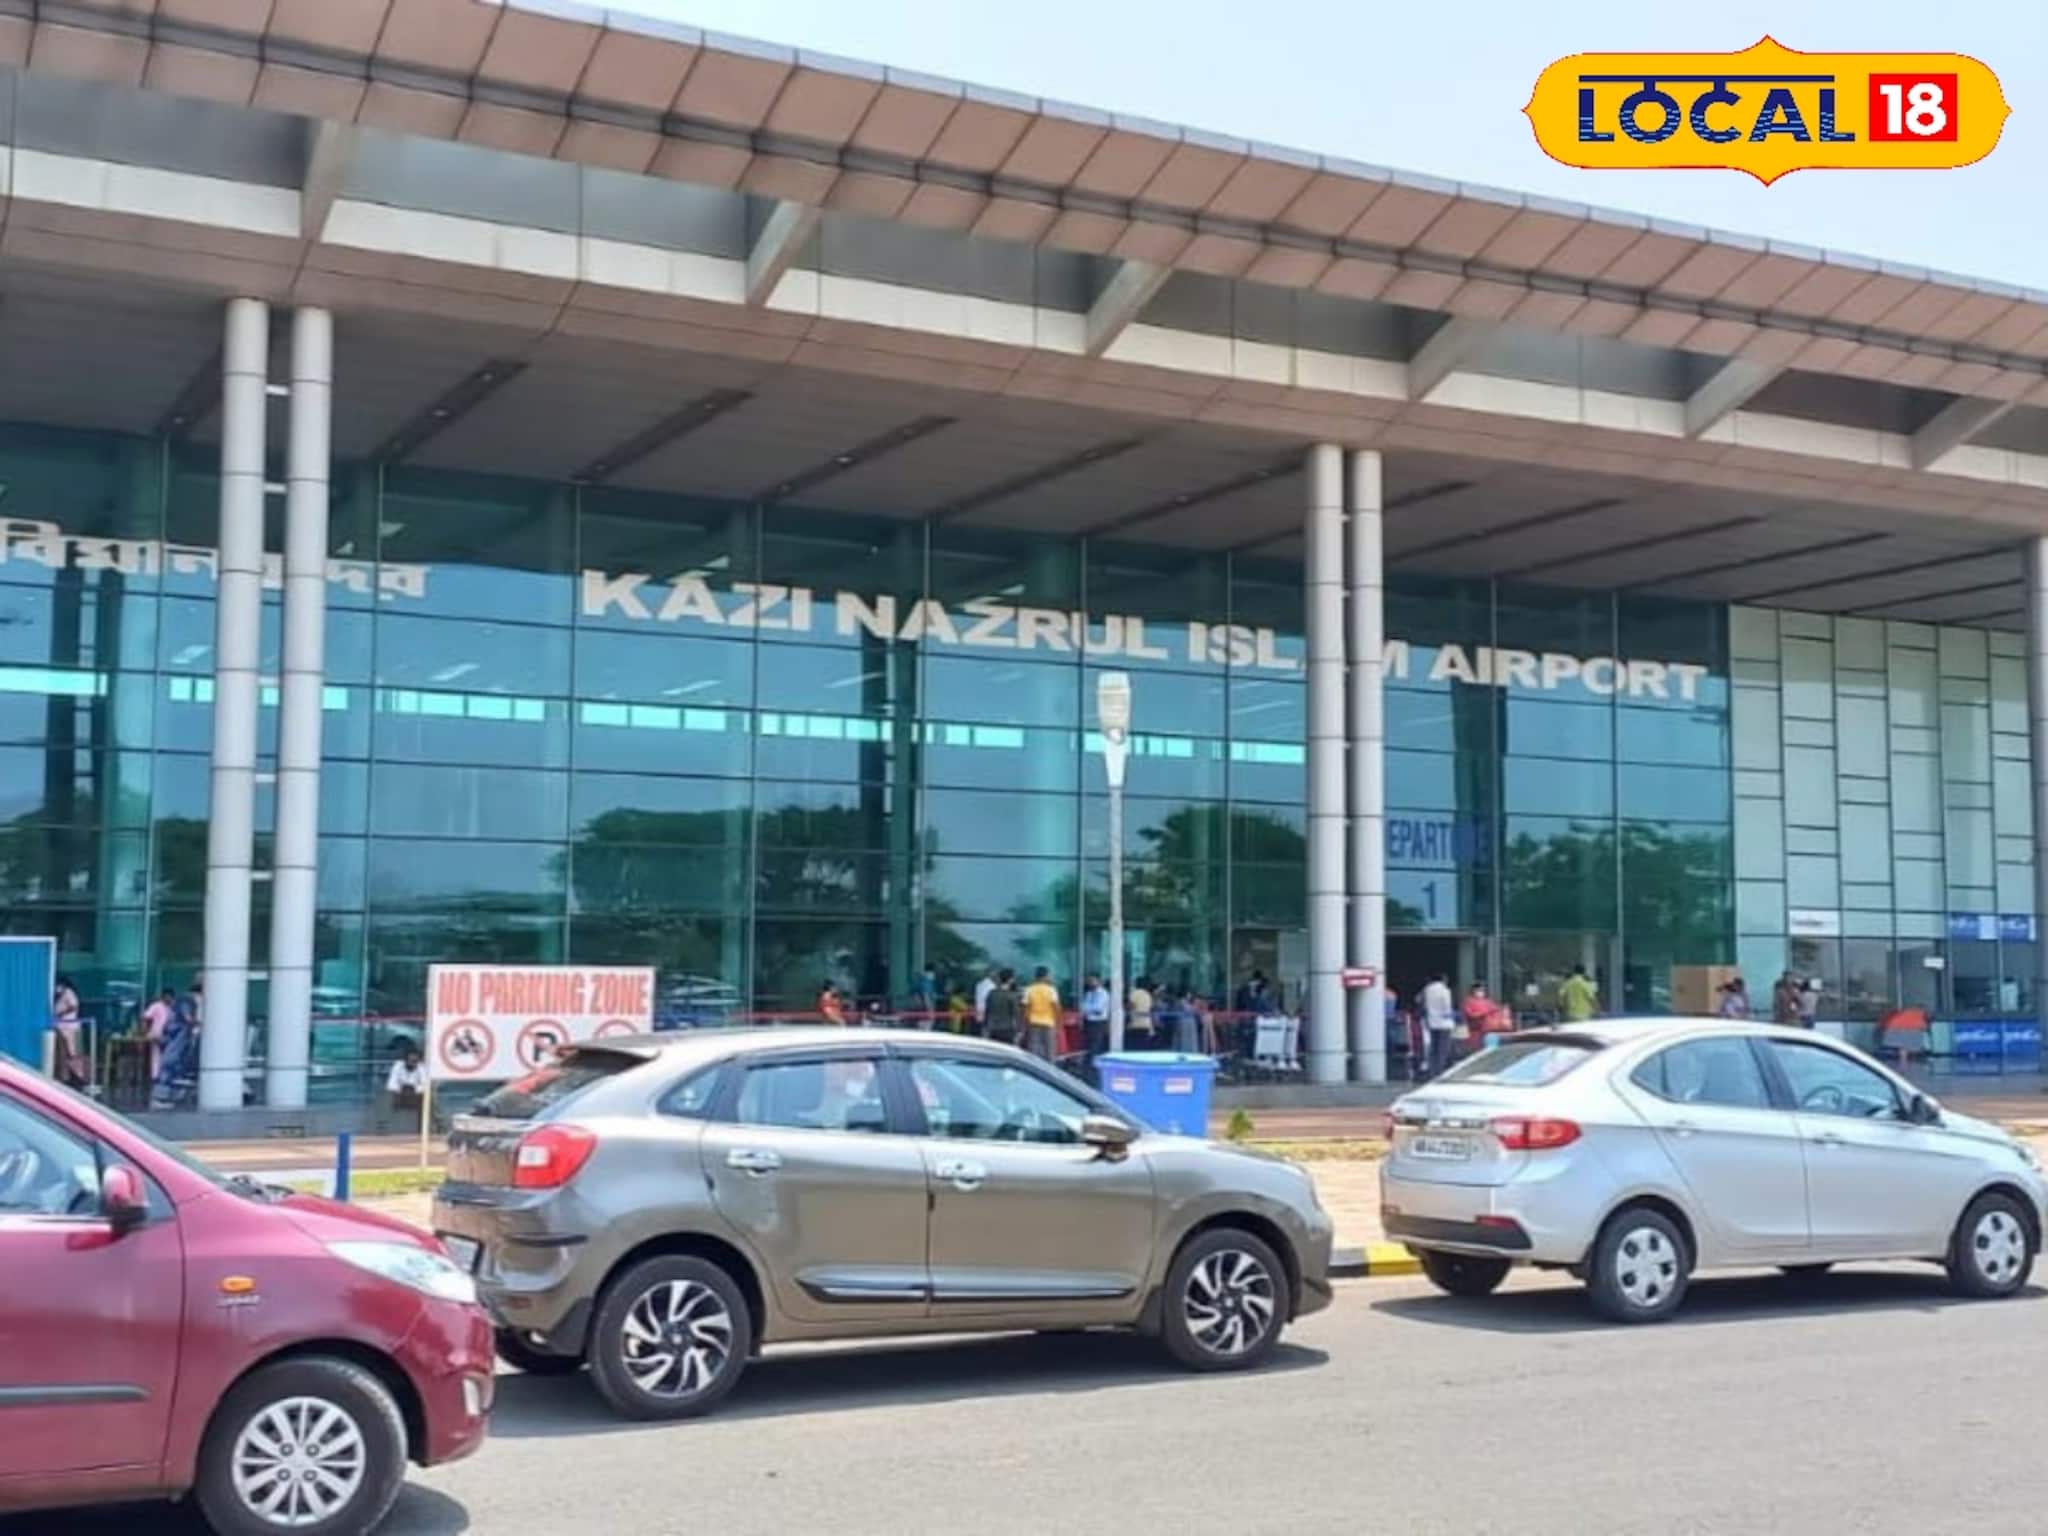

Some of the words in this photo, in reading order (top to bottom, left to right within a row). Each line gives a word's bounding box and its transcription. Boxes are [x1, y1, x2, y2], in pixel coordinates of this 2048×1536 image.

[581, 569, 813, 632] KAZI
[836, 591, 1168, 661] NAZRUL
[1188, 621, 1408, 679] ISLM
[1429, 643, 1708, 700] AIRPORT
[1421, 880, 1437, 919] 1
[437, 971, 473, 1015] NO
[478, 971, 586, 1015] PARKING
[589, 973, 650, 1015] ZONE
